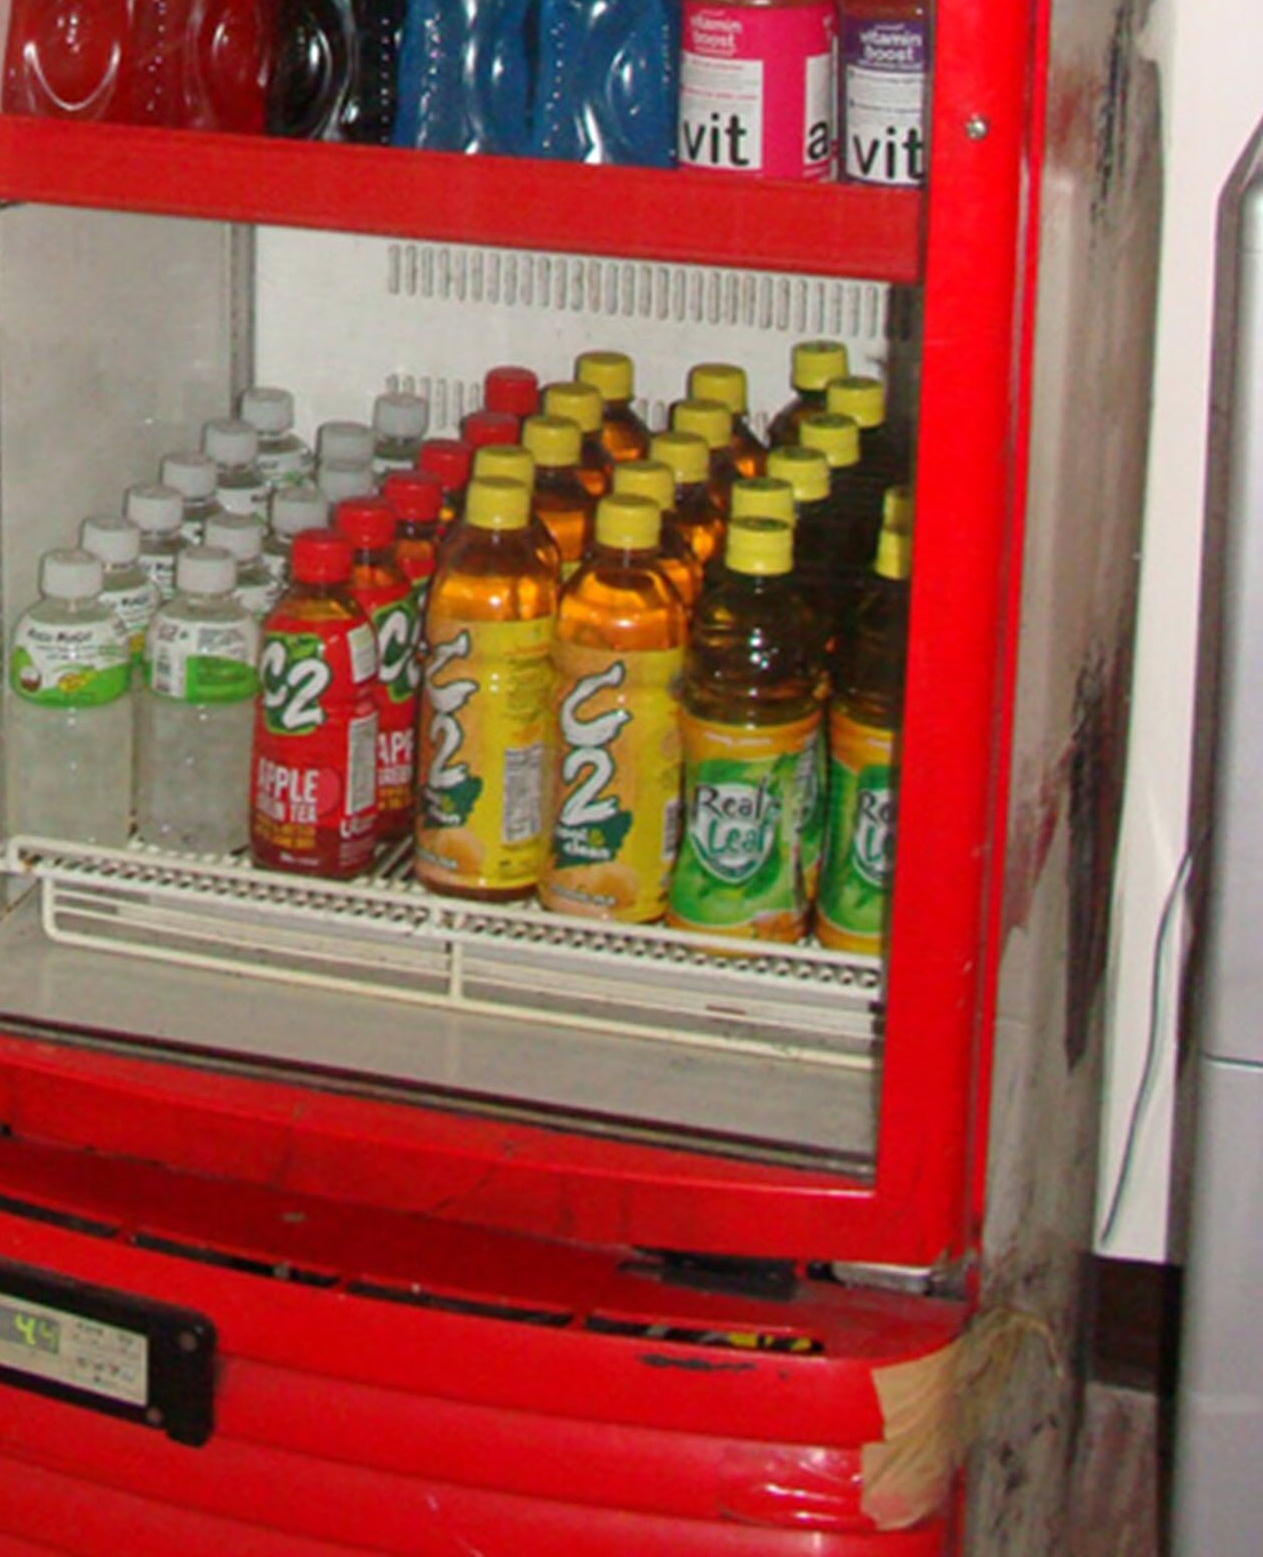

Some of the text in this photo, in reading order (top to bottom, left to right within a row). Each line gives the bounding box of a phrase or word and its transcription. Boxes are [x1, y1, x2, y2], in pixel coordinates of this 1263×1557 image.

[683, 112, 750, 167] vit
[852, 126, 925, 180] vit
[260, 639, 330, 729] C2
[559, 660, 632, 826] C2
[695, 777, 768, 820] Real
[858, 786, 893, 827] Re
[707, 822, 769, 857] Leaf
